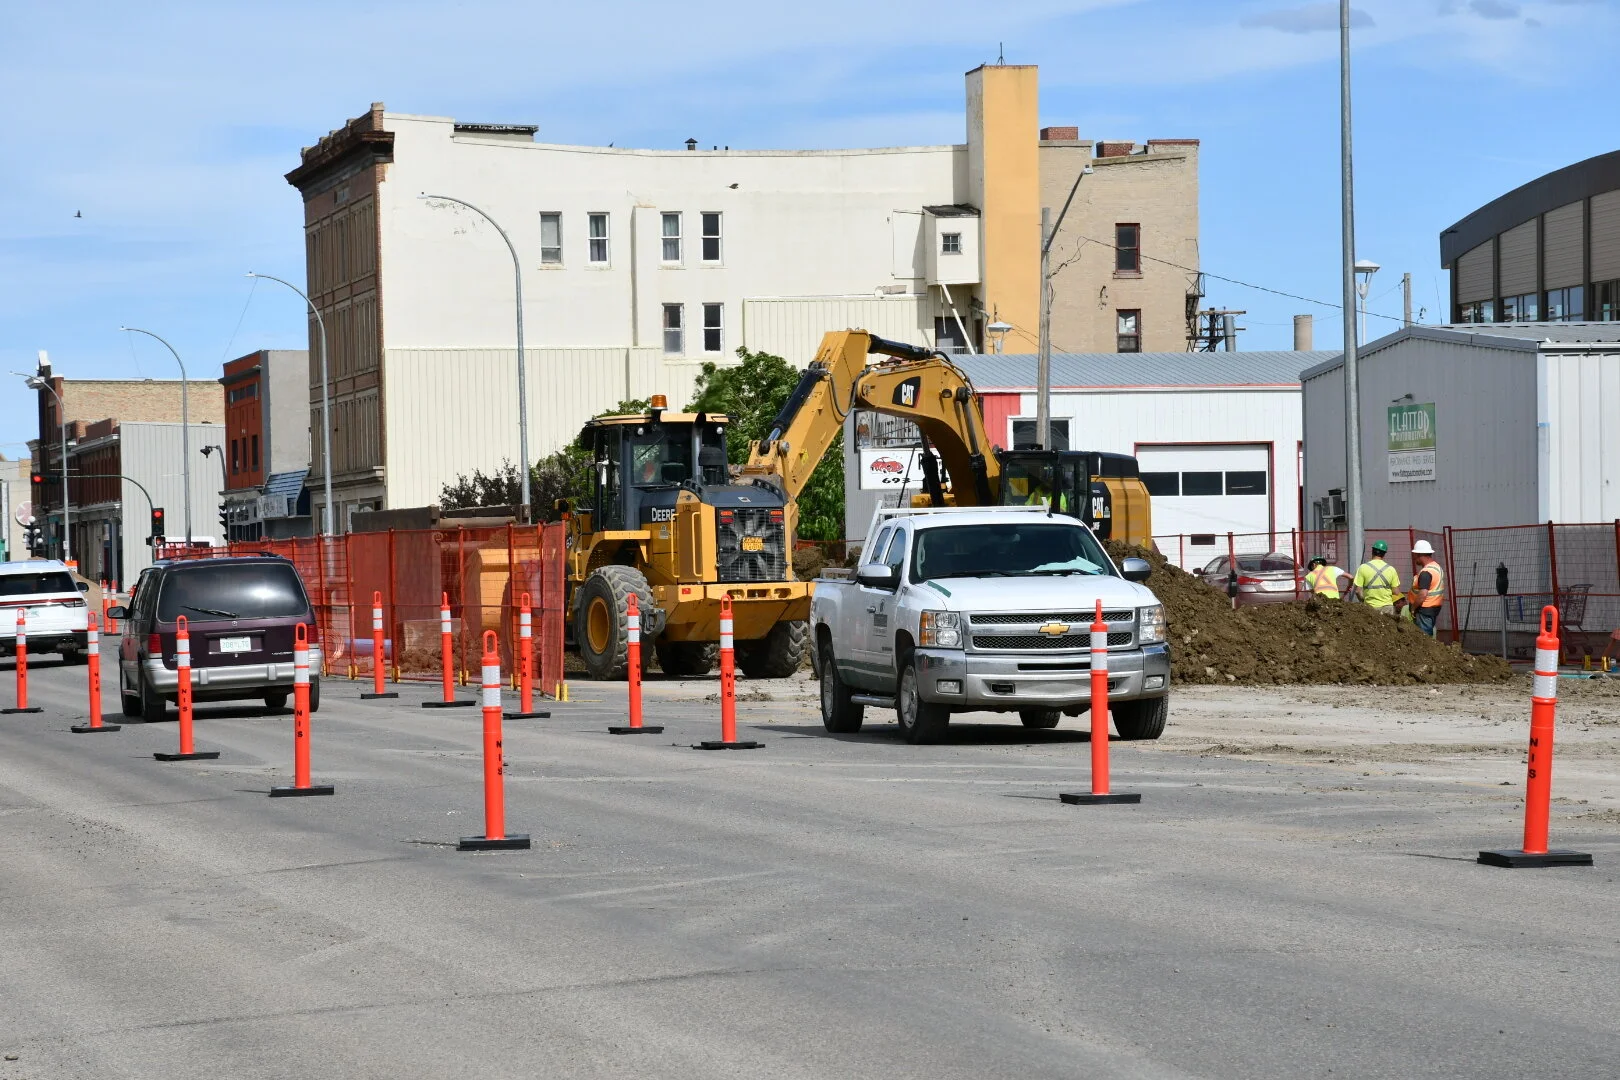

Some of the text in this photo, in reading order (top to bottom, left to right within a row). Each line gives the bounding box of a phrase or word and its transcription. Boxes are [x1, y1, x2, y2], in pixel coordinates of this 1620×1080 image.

[902, 384, 914, 405] CAT
[1390, 410, 1430, 442] FLATTOP
[651, 507, 675, 522] DEERE
[1092, 497, 1104, 518] CAT
[1528, 737, 1538, 779] NIS
